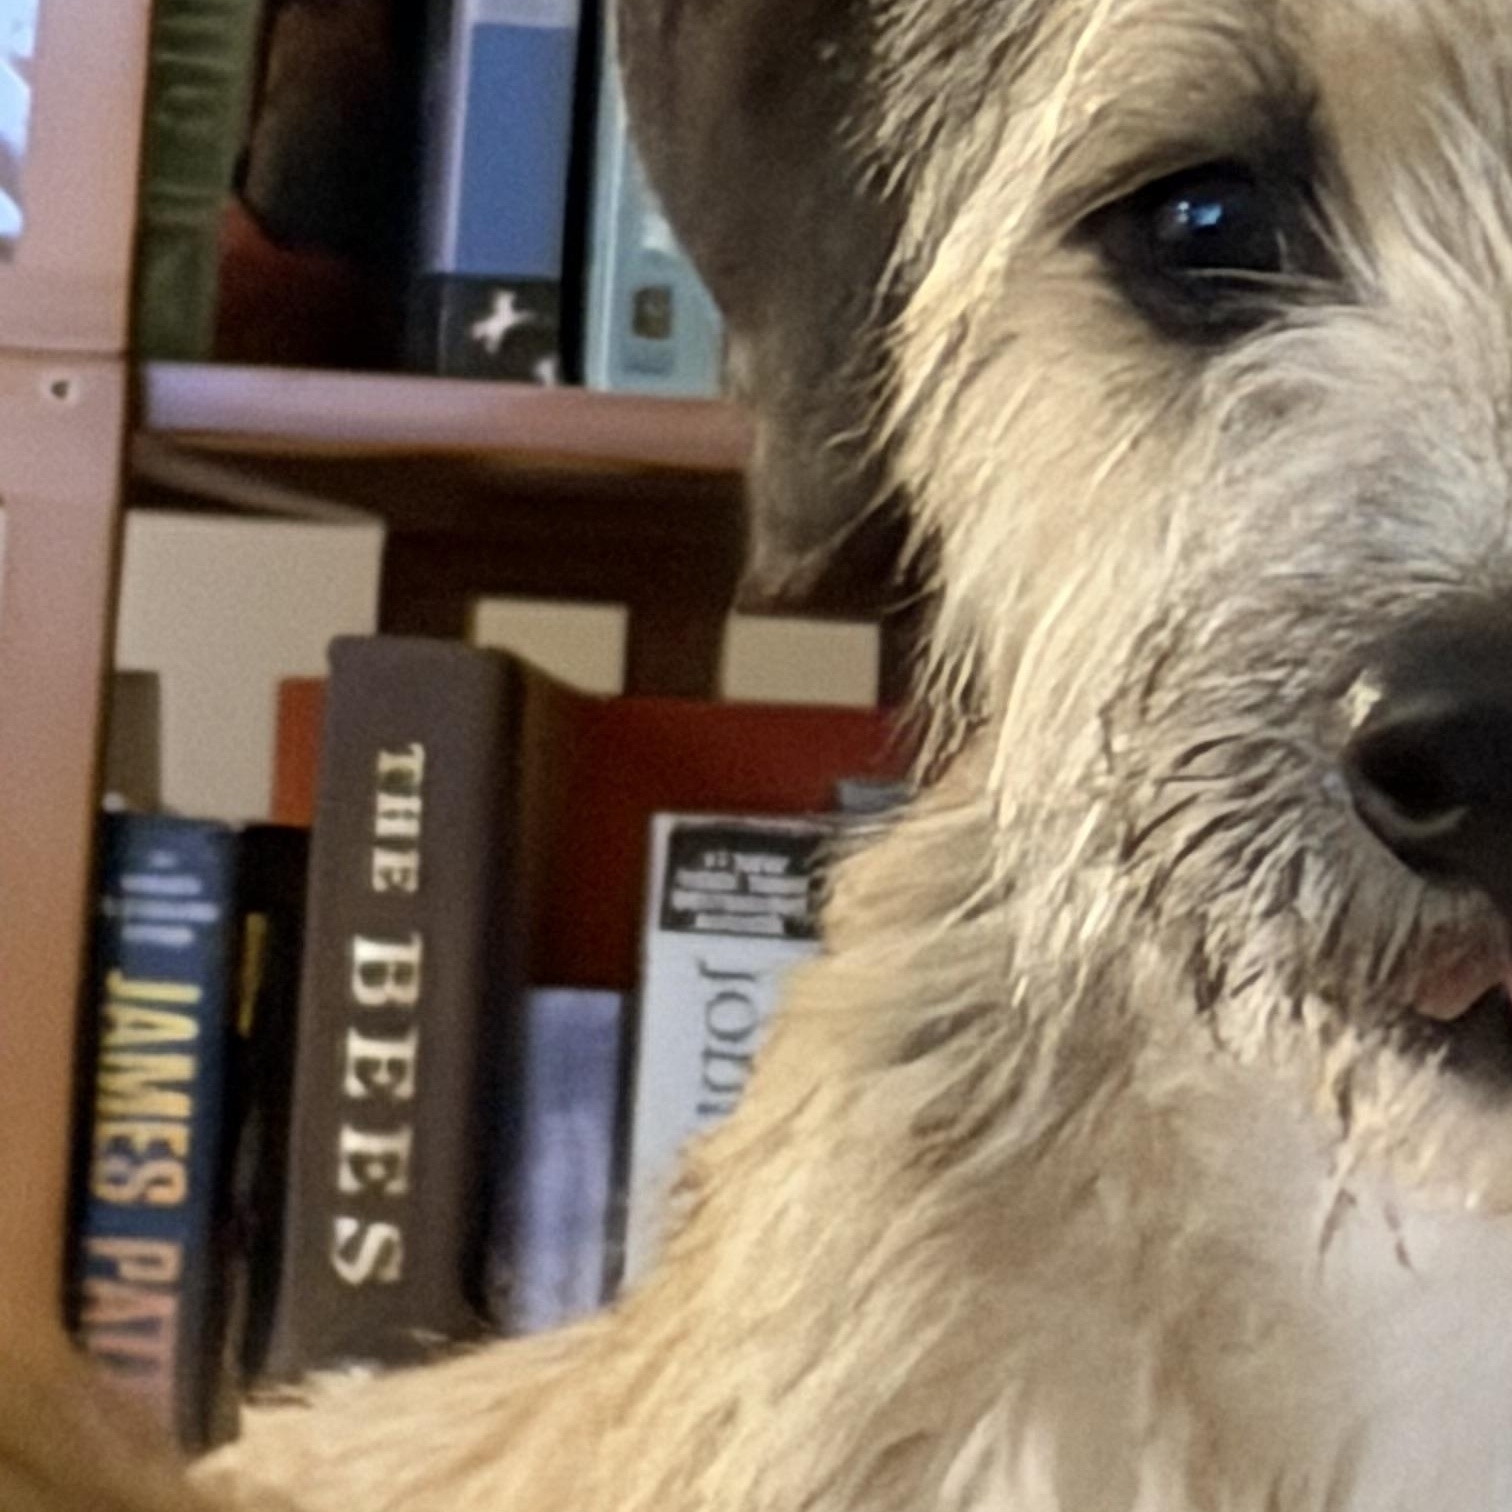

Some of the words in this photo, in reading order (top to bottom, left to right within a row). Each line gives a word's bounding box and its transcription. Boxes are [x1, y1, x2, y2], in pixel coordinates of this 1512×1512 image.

[371, 742, 425, 893] THE
[94, 970, 202, 1208] JAMES
[330, 932, 423, 1285] BEES
